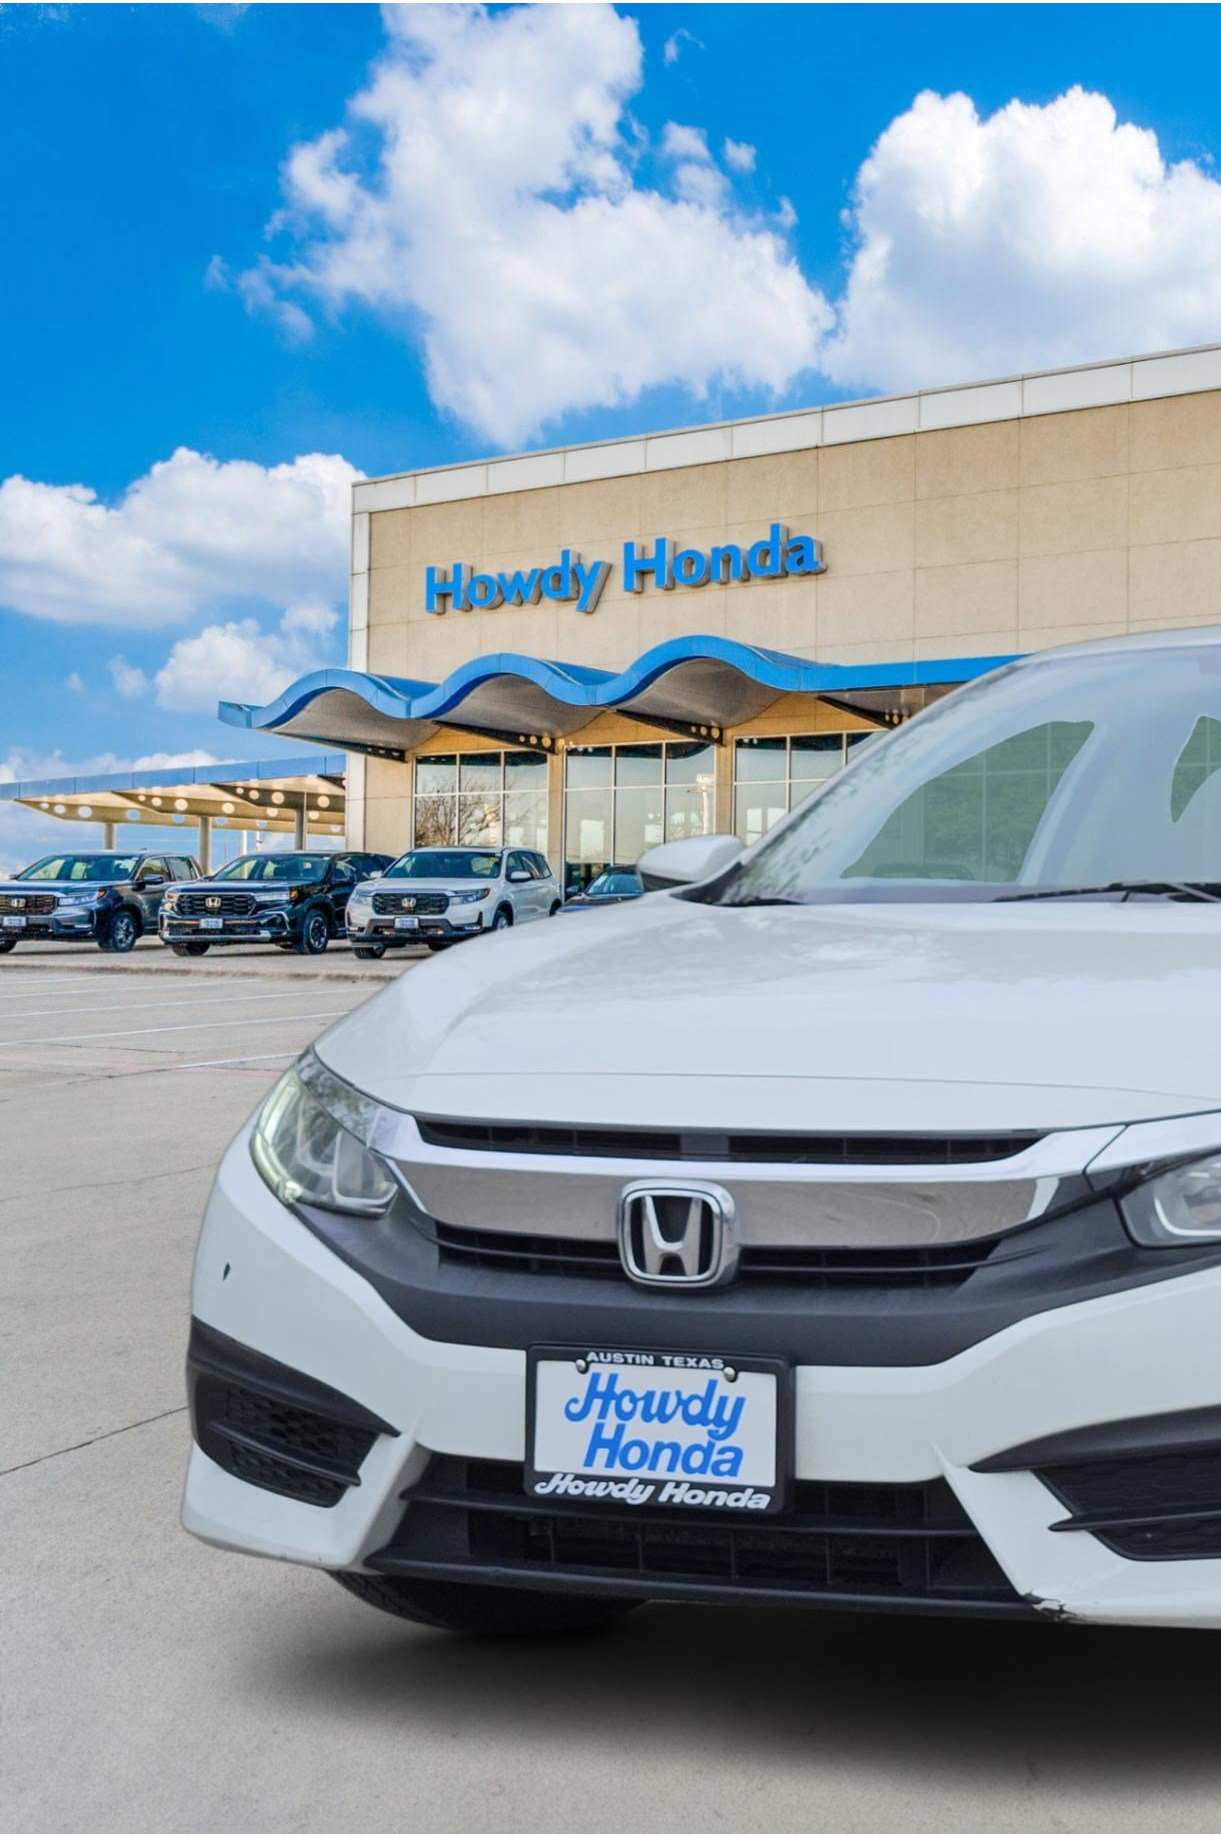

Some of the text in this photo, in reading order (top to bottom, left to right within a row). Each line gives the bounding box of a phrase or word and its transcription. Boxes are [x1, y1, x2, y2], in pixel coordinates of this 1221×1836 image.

[425, 523, 827, 615] Howdy Honda
[586, 1351, 724, 1370] AUSTIN TEXAS
[564, 1372, 746, 1441] Howdy
[583, 1422, 743, 1477] Honda
[534, 1473, 771, 1510] Howdy Honda
